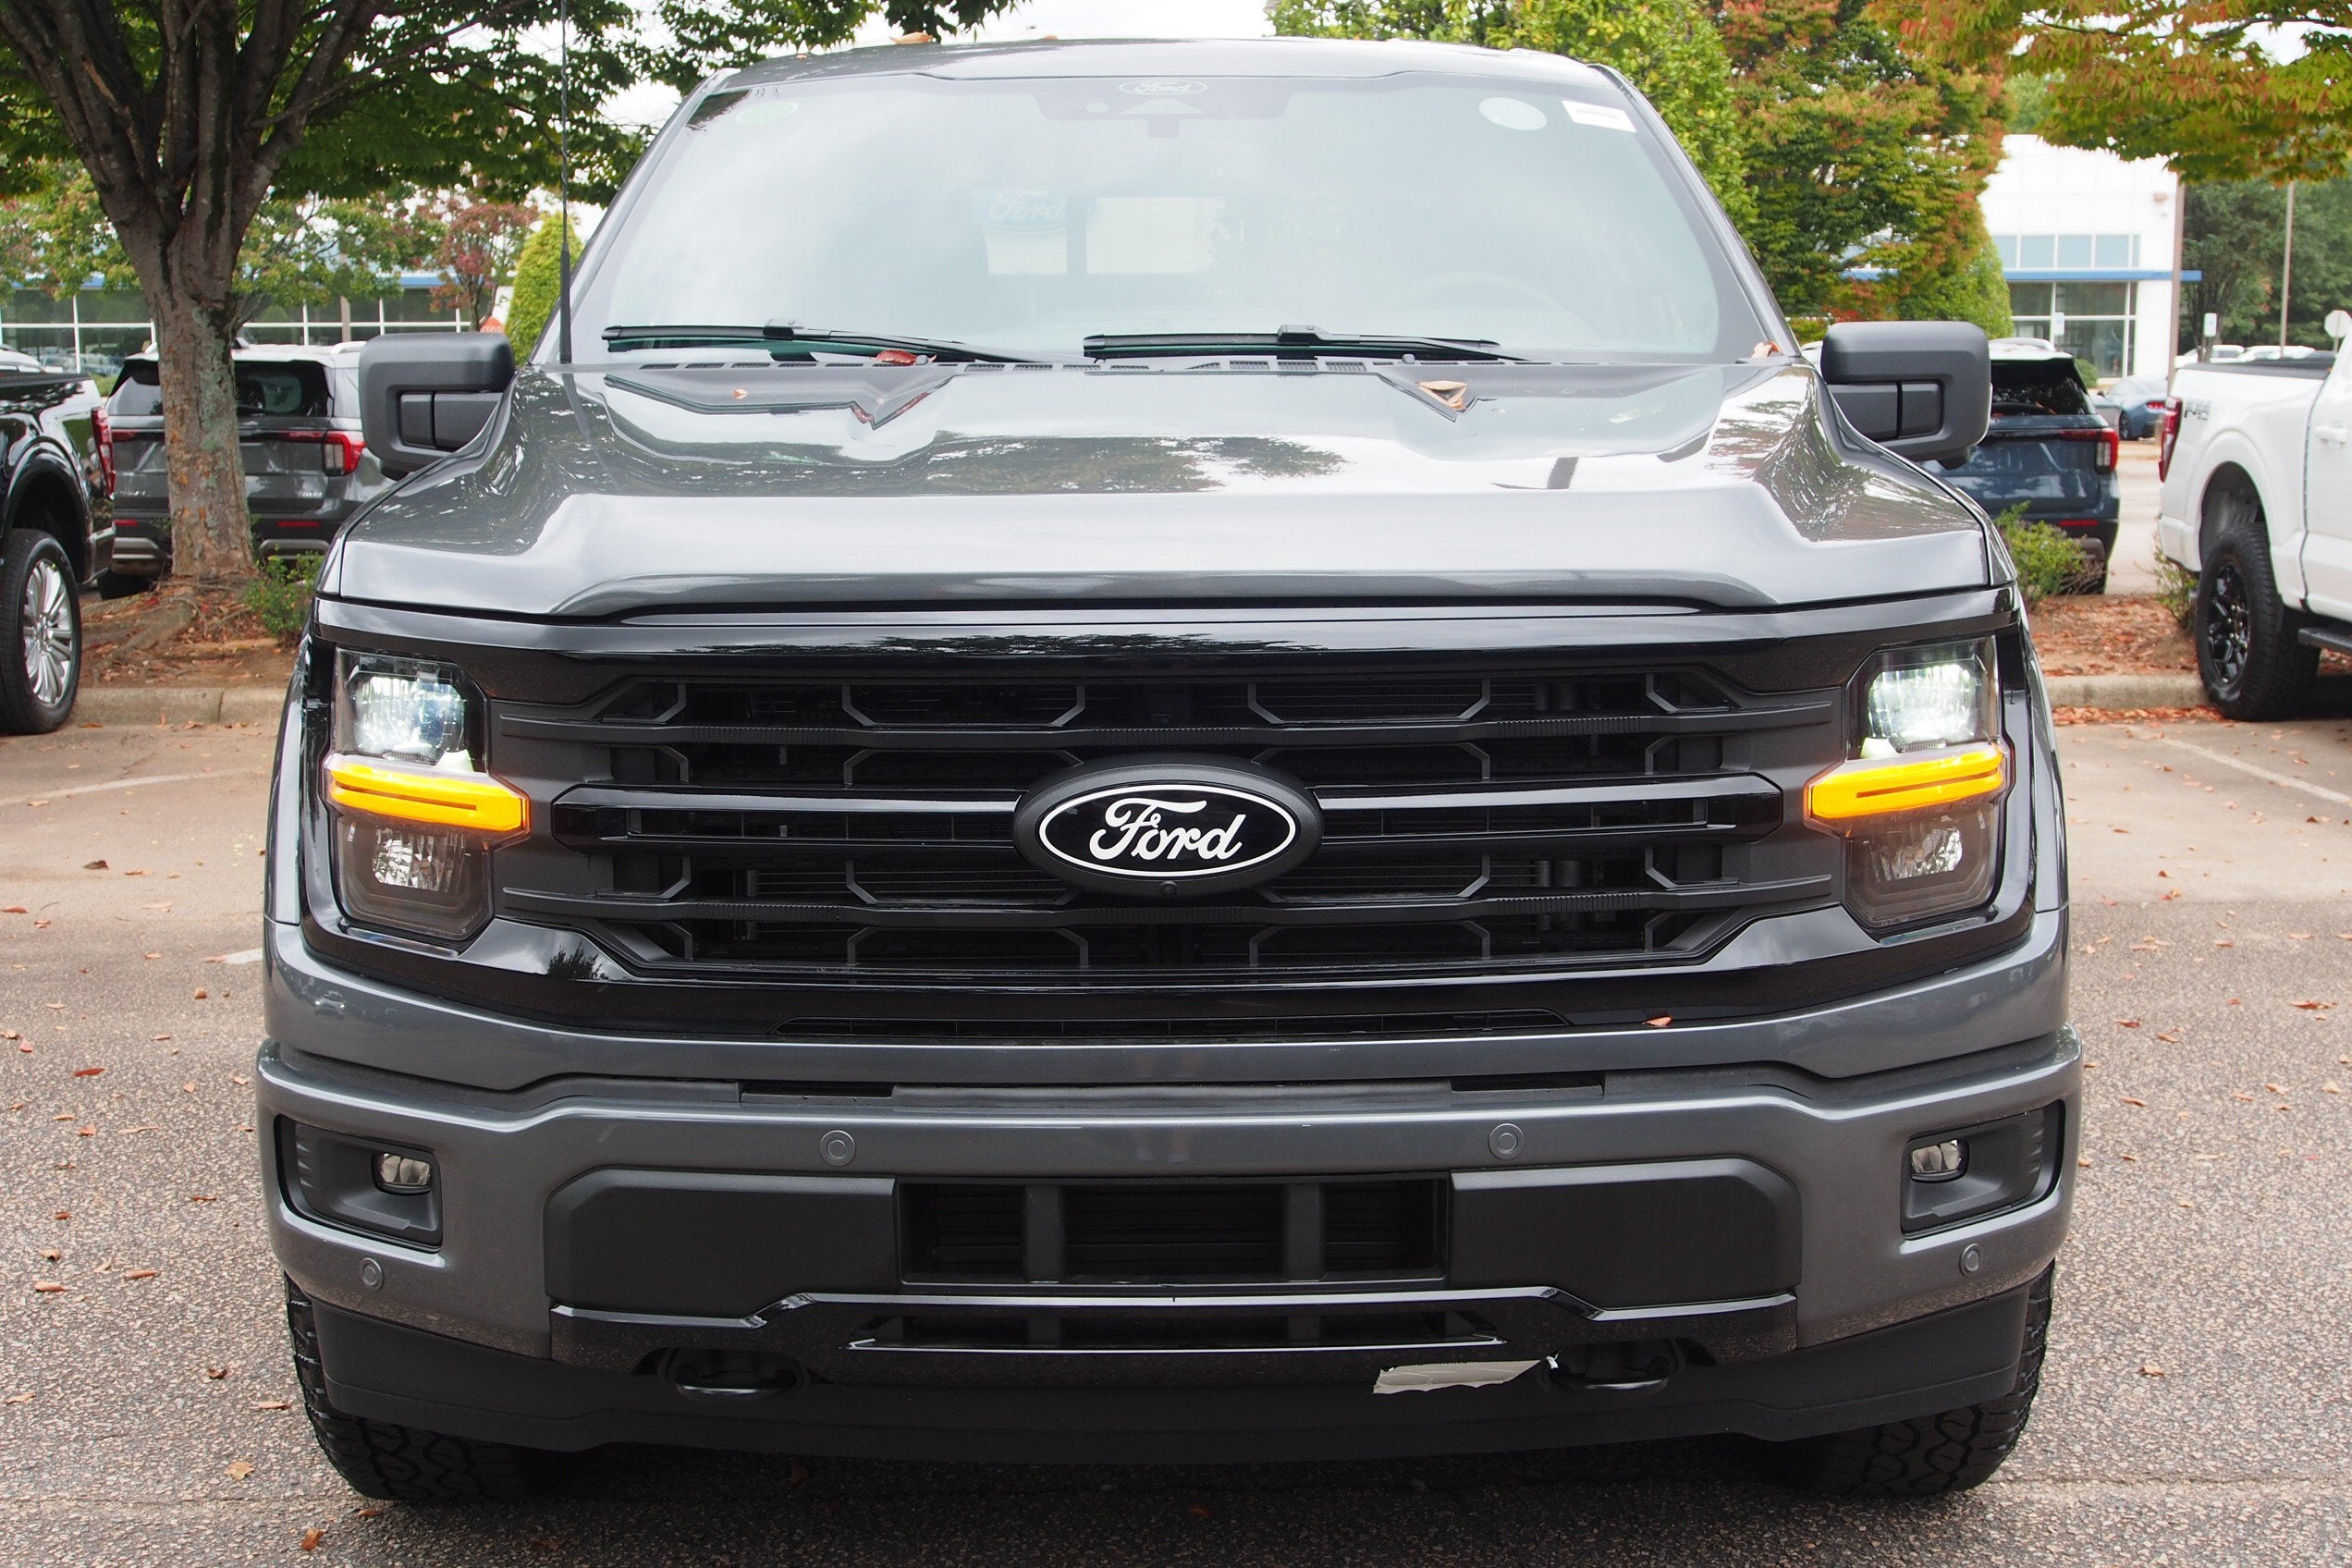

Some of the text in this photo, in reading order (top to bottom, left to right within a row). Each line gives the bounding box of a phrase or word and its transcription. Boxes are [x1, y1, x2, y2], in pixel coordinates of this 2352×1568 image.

[1133, 80, 1191, 92] Ford
[988, 189, 1066, 222] Ford
[1089, 798, 1246, 860] Ford
